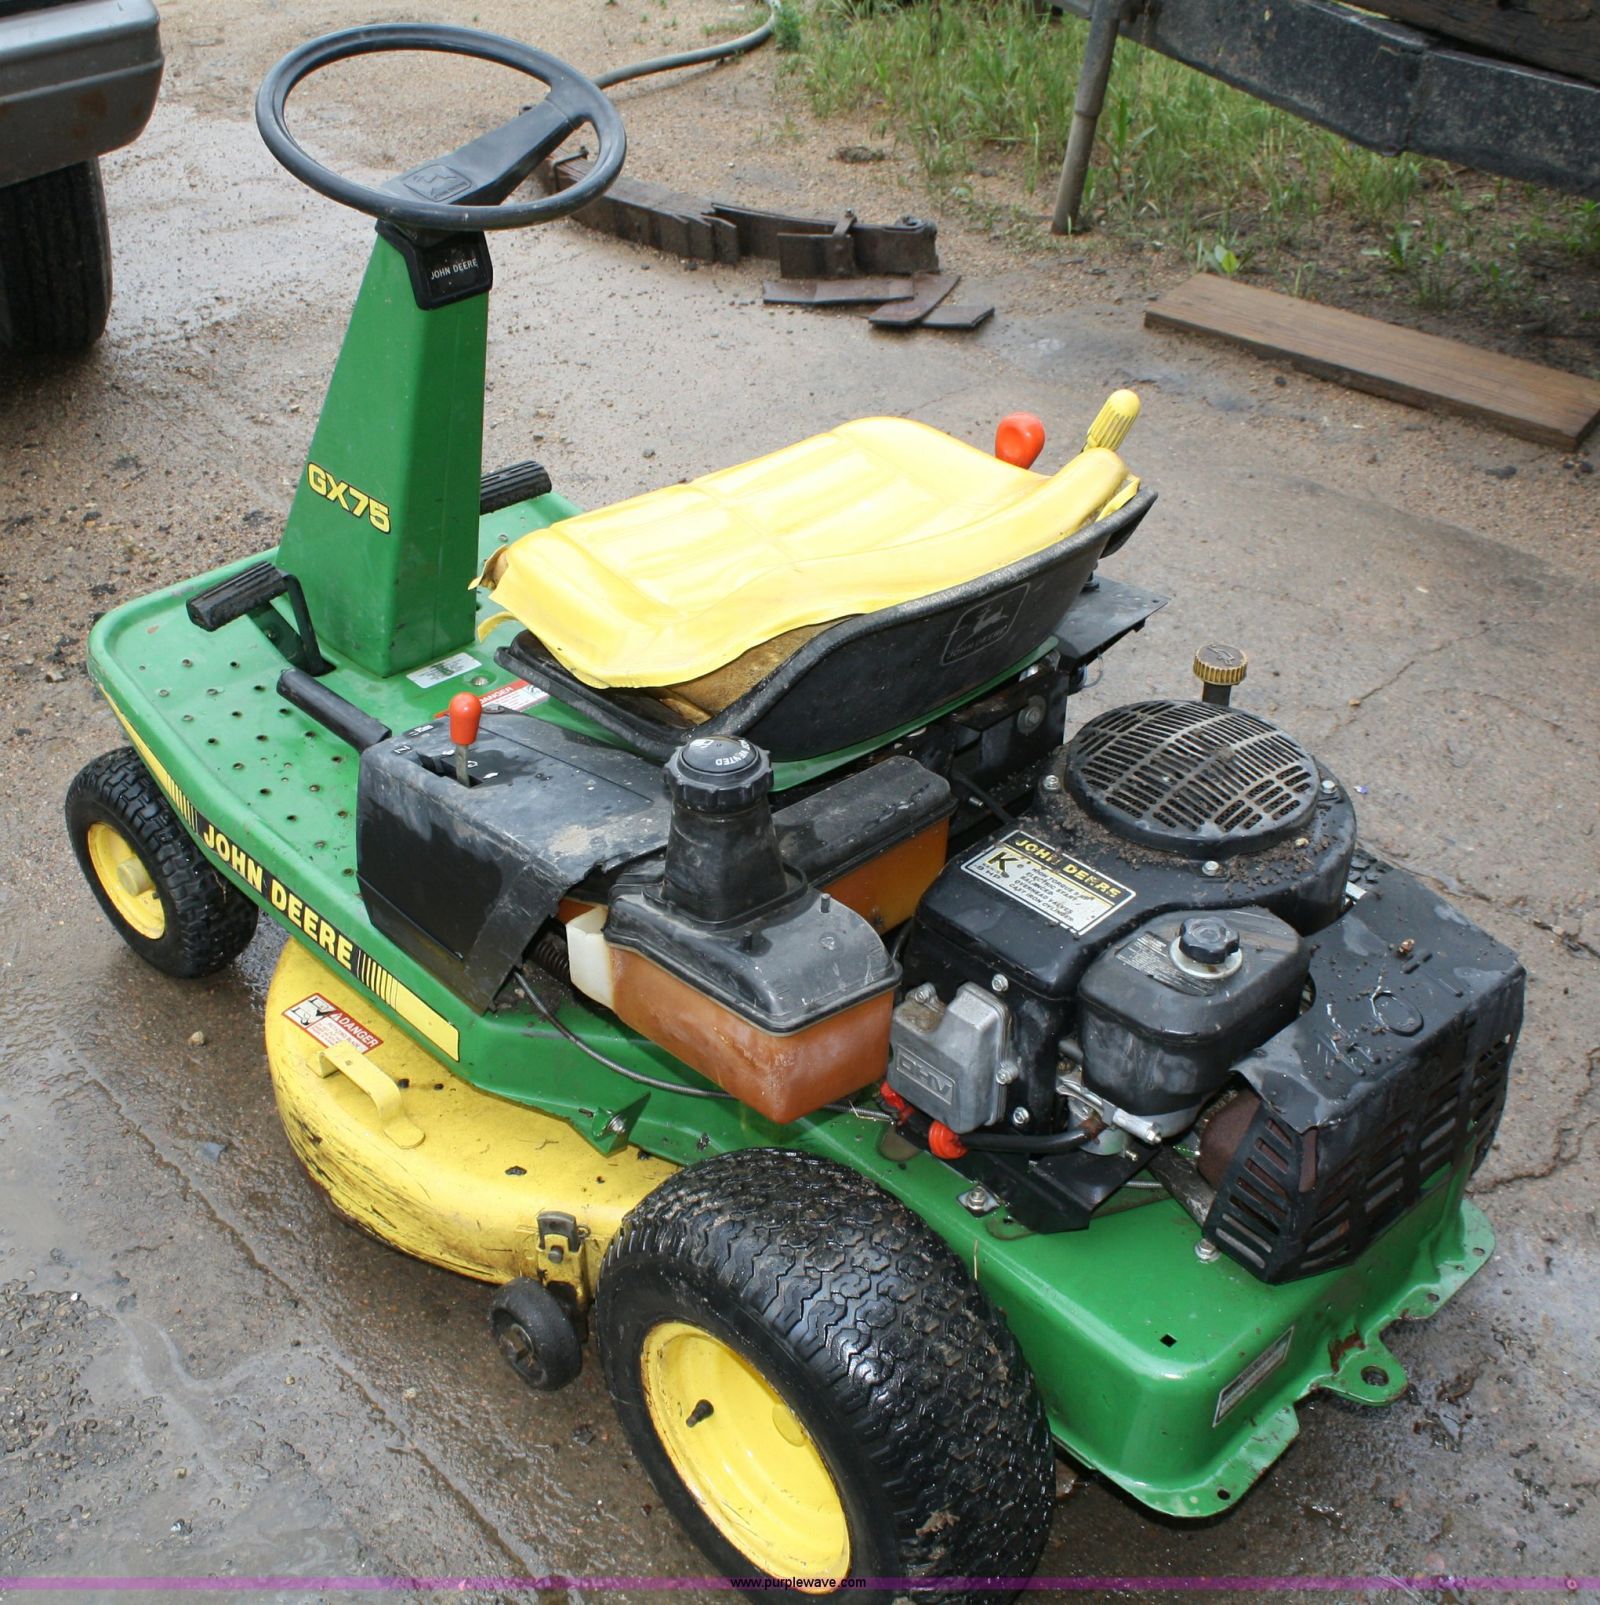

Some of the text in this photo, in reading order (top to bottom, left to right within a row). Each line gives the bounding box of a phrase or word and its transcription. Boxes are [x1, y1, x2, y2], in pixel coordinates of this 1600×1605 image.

[431, 258, 479, 280] JOHN DEERE
[307, 461, 391, 534] GX75
[203, 824, 353, 970] JOHN DEERE
[339, 1016, 380, 1048] DANGER
